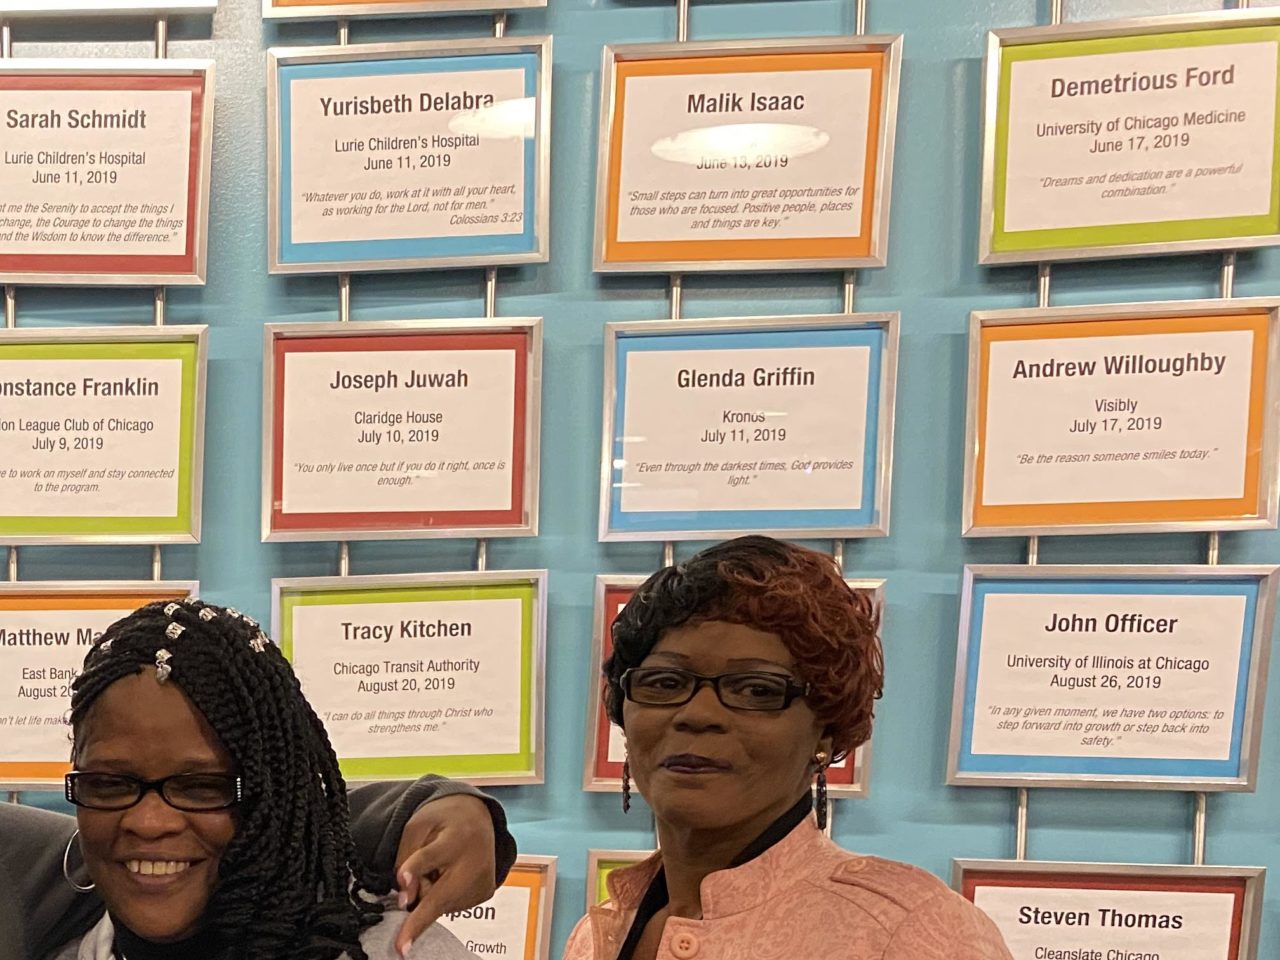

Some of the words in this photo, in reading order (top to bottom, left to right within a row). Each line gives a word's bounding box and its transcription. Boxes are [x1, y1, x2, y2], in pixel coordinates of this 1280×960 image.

[1051, 72, 1177, 98] Demetrious
[1185, 64, 1234, 87] Ford
[320, 94, 412, 116] Yurisbeth
[420, 91, 494, 112] Delabra
[687, 93, 743, 113] Malik
[750, 92, 804, 111] Isaac
[6, 109, 61, 128] Sarah
[67, 109, 146, 129] Schmidt
[1036, 120, 1102, 137] University
[1106, 117, 1121, 132] of
[1124, 116, 1179, 131] Chicago
[1183, 110, 1246, 126] Medicine
[5, 151, 34, 165] Lurie
[37, 151, 96, 165] Children's
[99, 151, 146, 167] Hospital
[32, 170, 61, 184] June
[65, 170, 82, 186] 11,
[87, 170, 117, 184] 2019
[628, 190, 660, 202] "Small
[659, 191, 687, 202] steps
[688, 191, 707, 200] can
[708, 190, 729, 200] turn
[730, 189, 750, 199] into
[750, 188, 778, 201] great
[778, 187, 843, 200] opportunities
[844, 186, 860, 196] for
[1012, 358, 1096, 379] Andrew
[1104, 352, 1226, 377] Willoughby
[83, 377, 158, 396] Franklin
[330, 370, 398, 393] Joseph
[404, 369, 468, 388] Juwah
[678, 369, 745, 388] Glenda
[753, 367, 815, 387] Griffin
[1095, 398, 1138, 414] Visibly
[19, 418, 60, 434] League
[64, 418, 89, 432] Club
[93, 418, 105, 431] of
[107, 418, 154, 434] Chicago
[354, 411, 403, 427] Claridge
[406, 411, 443, 424] House
[723, 410, 766, 423] Kronos
[1017, 454, 1034, 464] "Be
[1036, 454, 1053, 464] the
[1055, 454, 1091, 463] reason
[1092, 452, 1141, 462] someone
[1142, 449, 1177, 460] smiles
[1179, 448, 1218, 460] today."
[341, 622, 393, 643] Tracy
[400, 619, 471, 638] Kitchen
[1045, 613, 1097, 632] John
[1105, 614, 1178, 633] Officer
[333, 662, 380, 677] Chicago
[383, 660, 424, 673] Transit
[426, 658, 480, 673] Authority
[1007, 654, 1071, 671] University
[1075, 655, 1089, 669] of
[1092, 656, 1134, 669] Illinois
[1138, 657, 1152, 670] at
[1155, 656, 1209, 673] Chicago
[22, 668, 46, 680] East
[50, 668, 78, 679] Bank
[1018, 906, 1090, 926] Steven
[1098, 909, 1183, 929] Thomas
